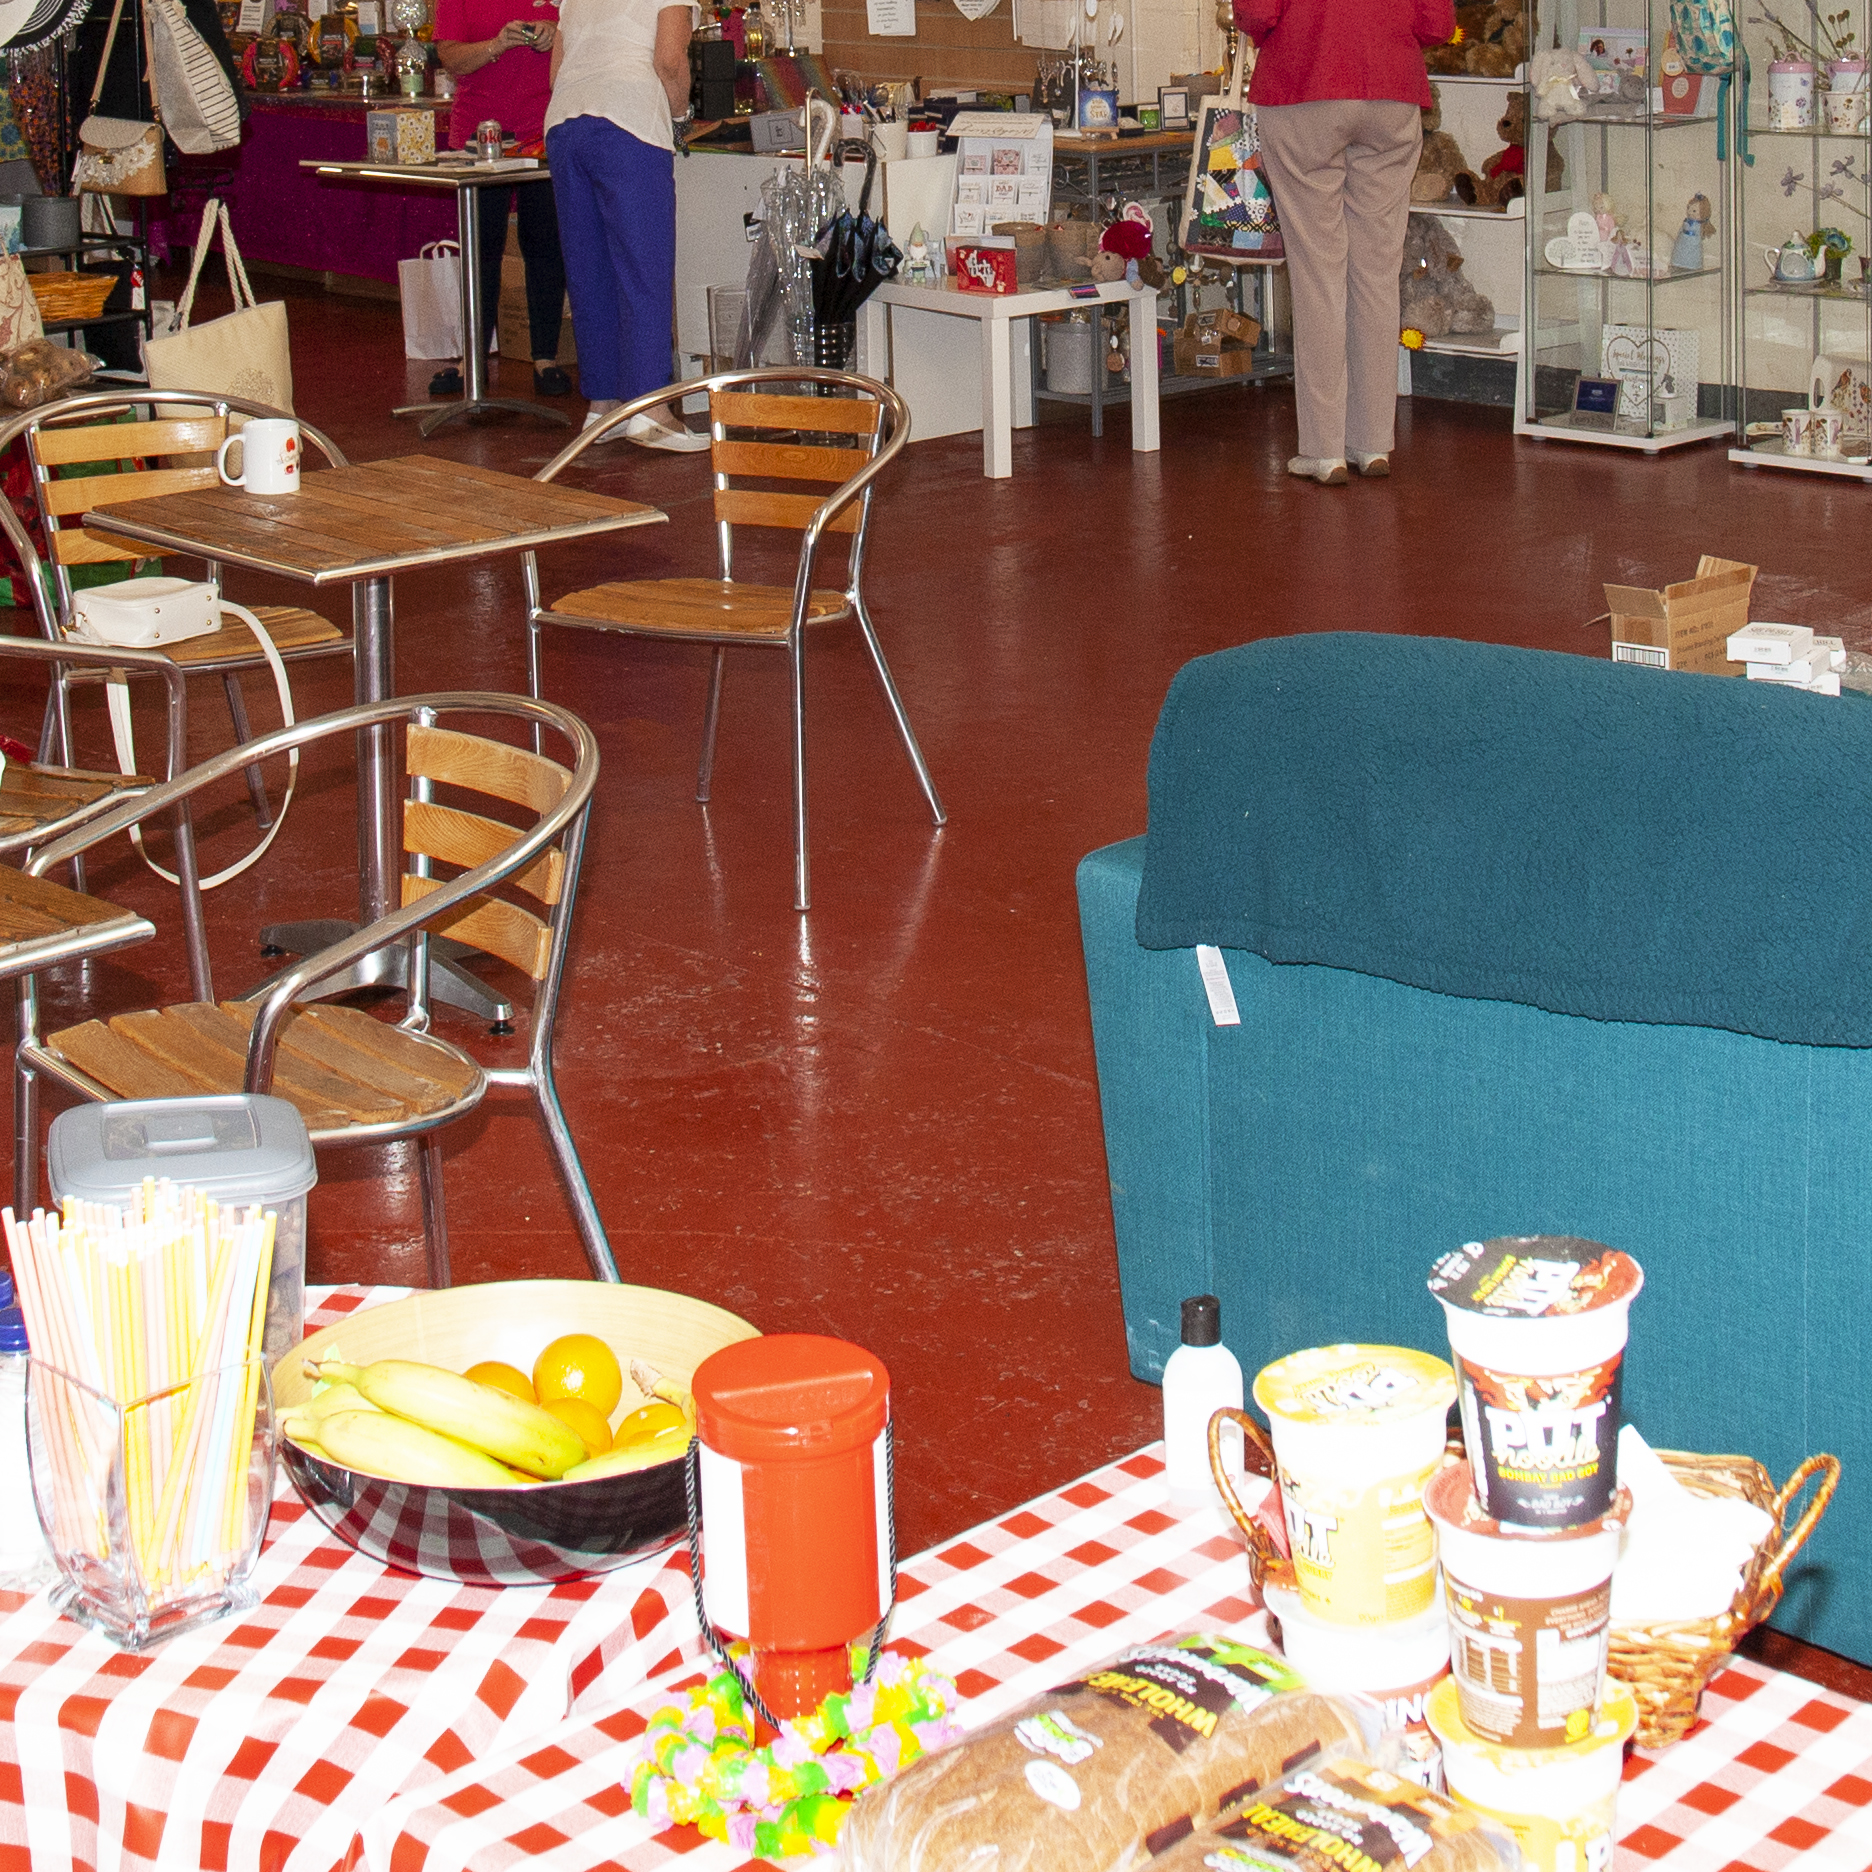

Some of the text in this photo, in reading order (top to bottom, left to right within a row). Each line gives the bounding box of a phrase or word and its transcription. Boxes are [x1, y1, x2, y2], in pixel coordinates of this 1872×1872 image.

[1497, 1462, 1600, 1484] BOMBAY BAD BOY
